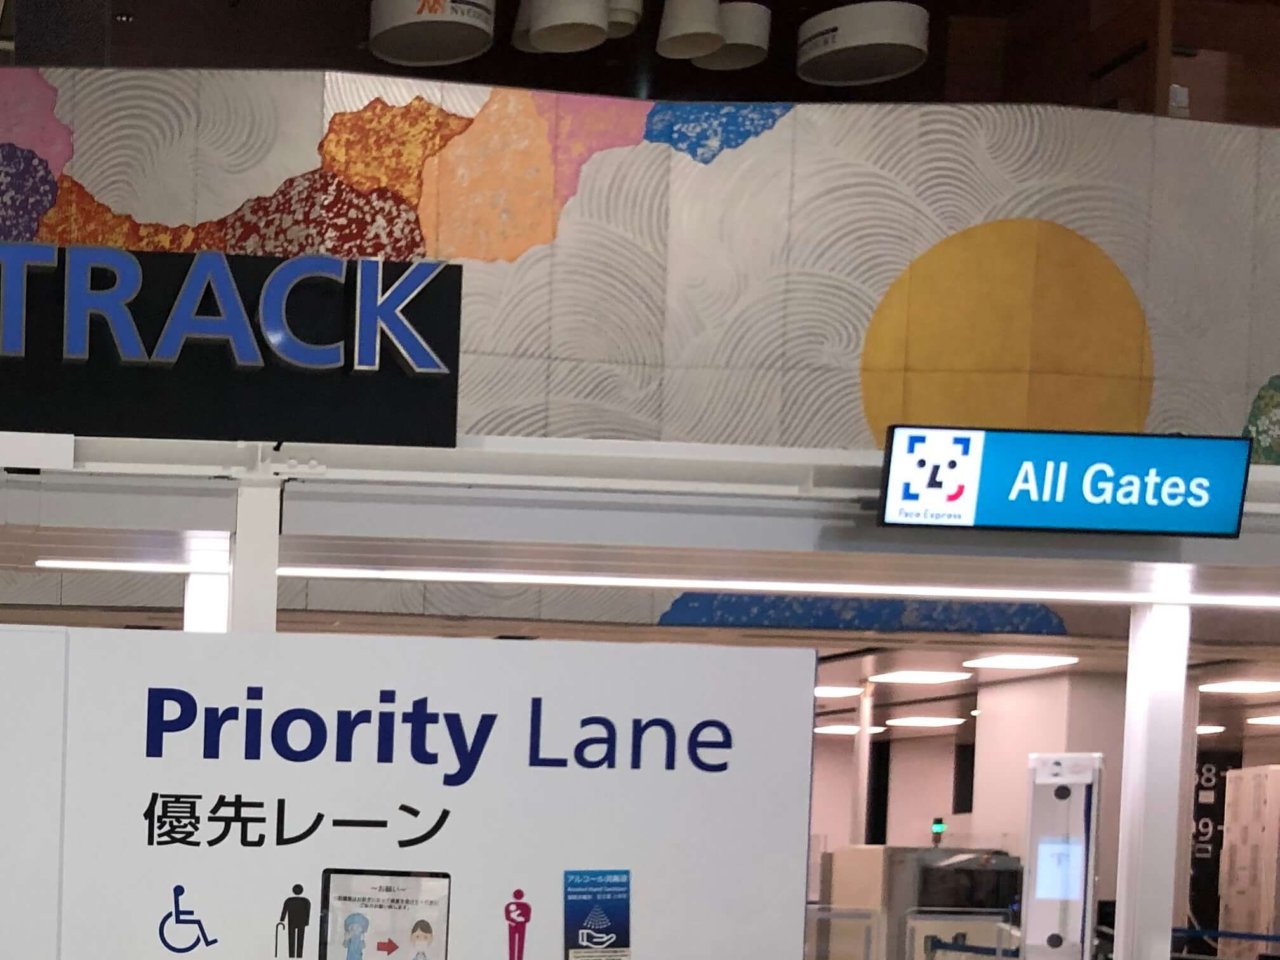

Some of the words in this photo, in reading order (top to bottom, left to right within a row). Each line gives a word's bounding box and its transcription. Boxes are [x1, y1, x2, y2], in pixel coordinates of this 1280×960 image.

[1008, 460, 1068, 502] All
[1082, 463, 1210, 508] Gates
[145, 686, 498, 787] Priority
[528, 697, 734, 772] Lane
[143, 792, 452, 848] 優先レーン
